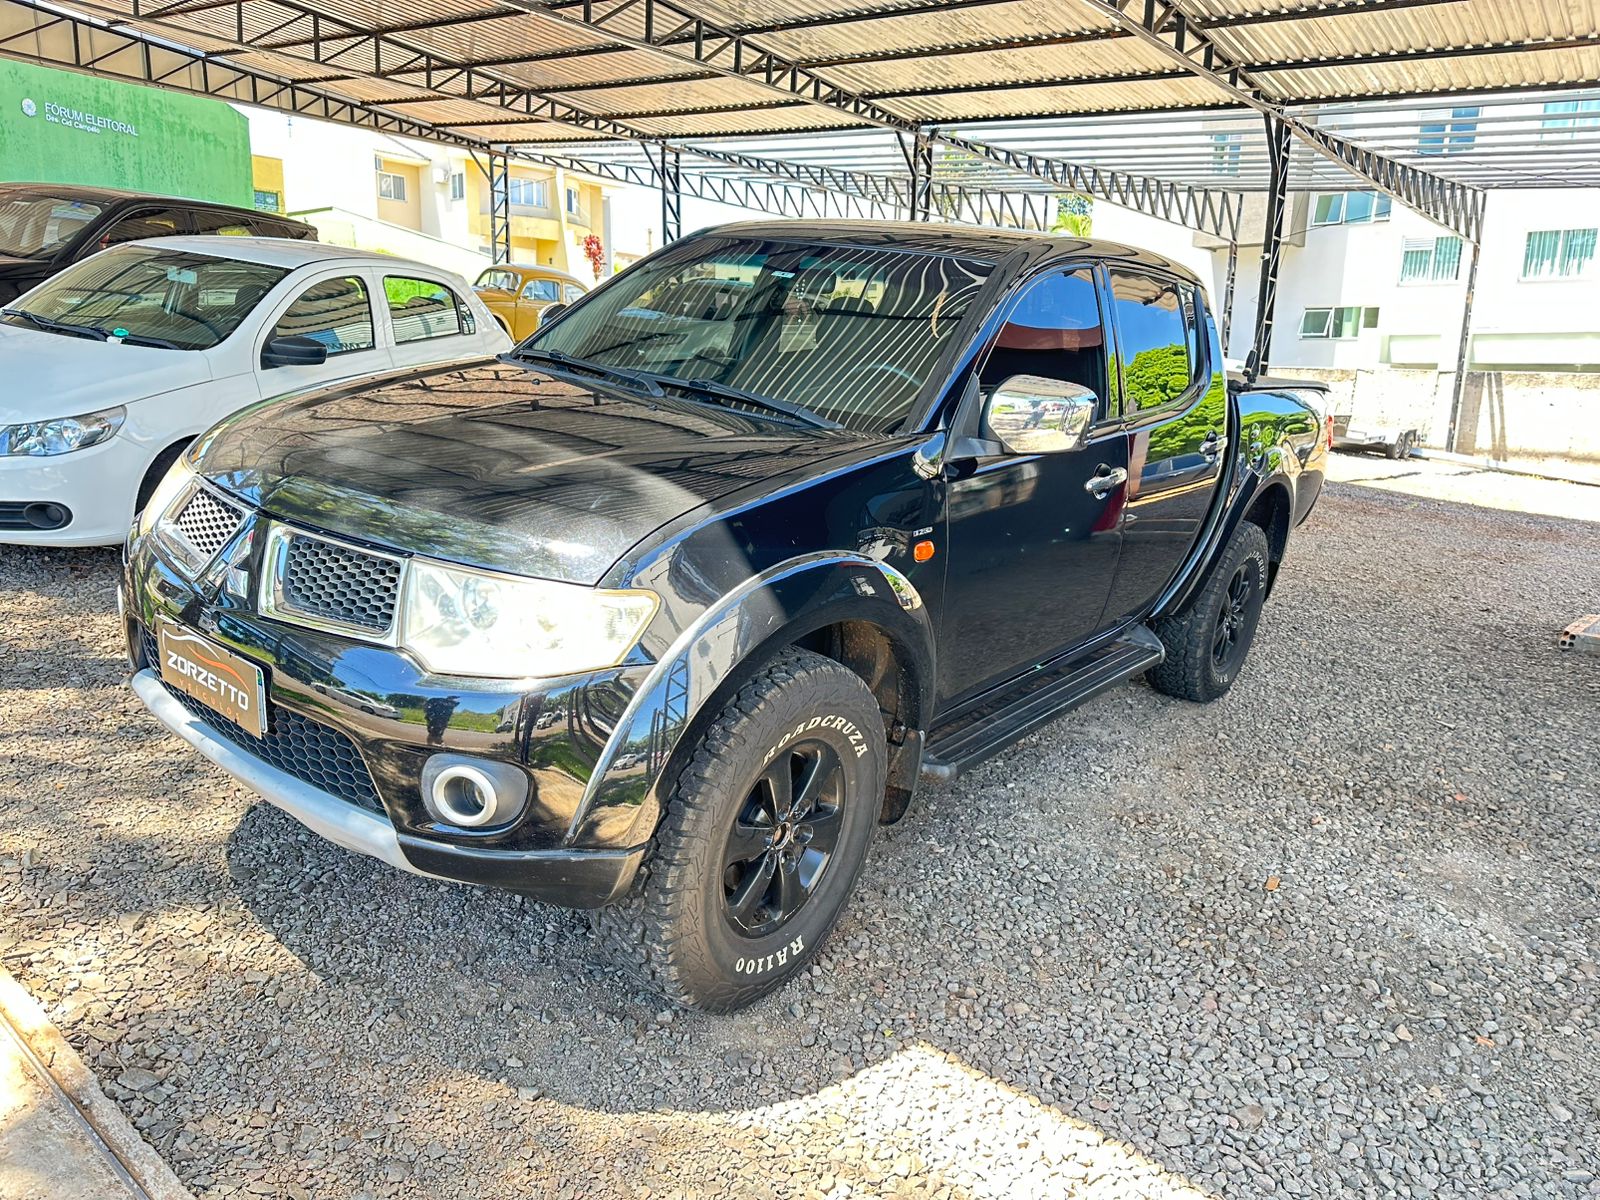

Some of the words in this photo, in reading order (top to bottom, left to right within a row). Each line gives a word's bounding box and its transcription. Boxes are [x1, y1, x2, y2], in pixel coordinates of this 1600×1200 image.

[44, 102, 83, 122] FÓRUM
[85, 113, 139, 137] ELEITORAL
[61, 117, 73, 127] Cid
[167, 649, 249, 711] ZORZETTO
[761, 714, 869, 768] ROADCRUZA
[735, 934, 805, 975] RA1100
